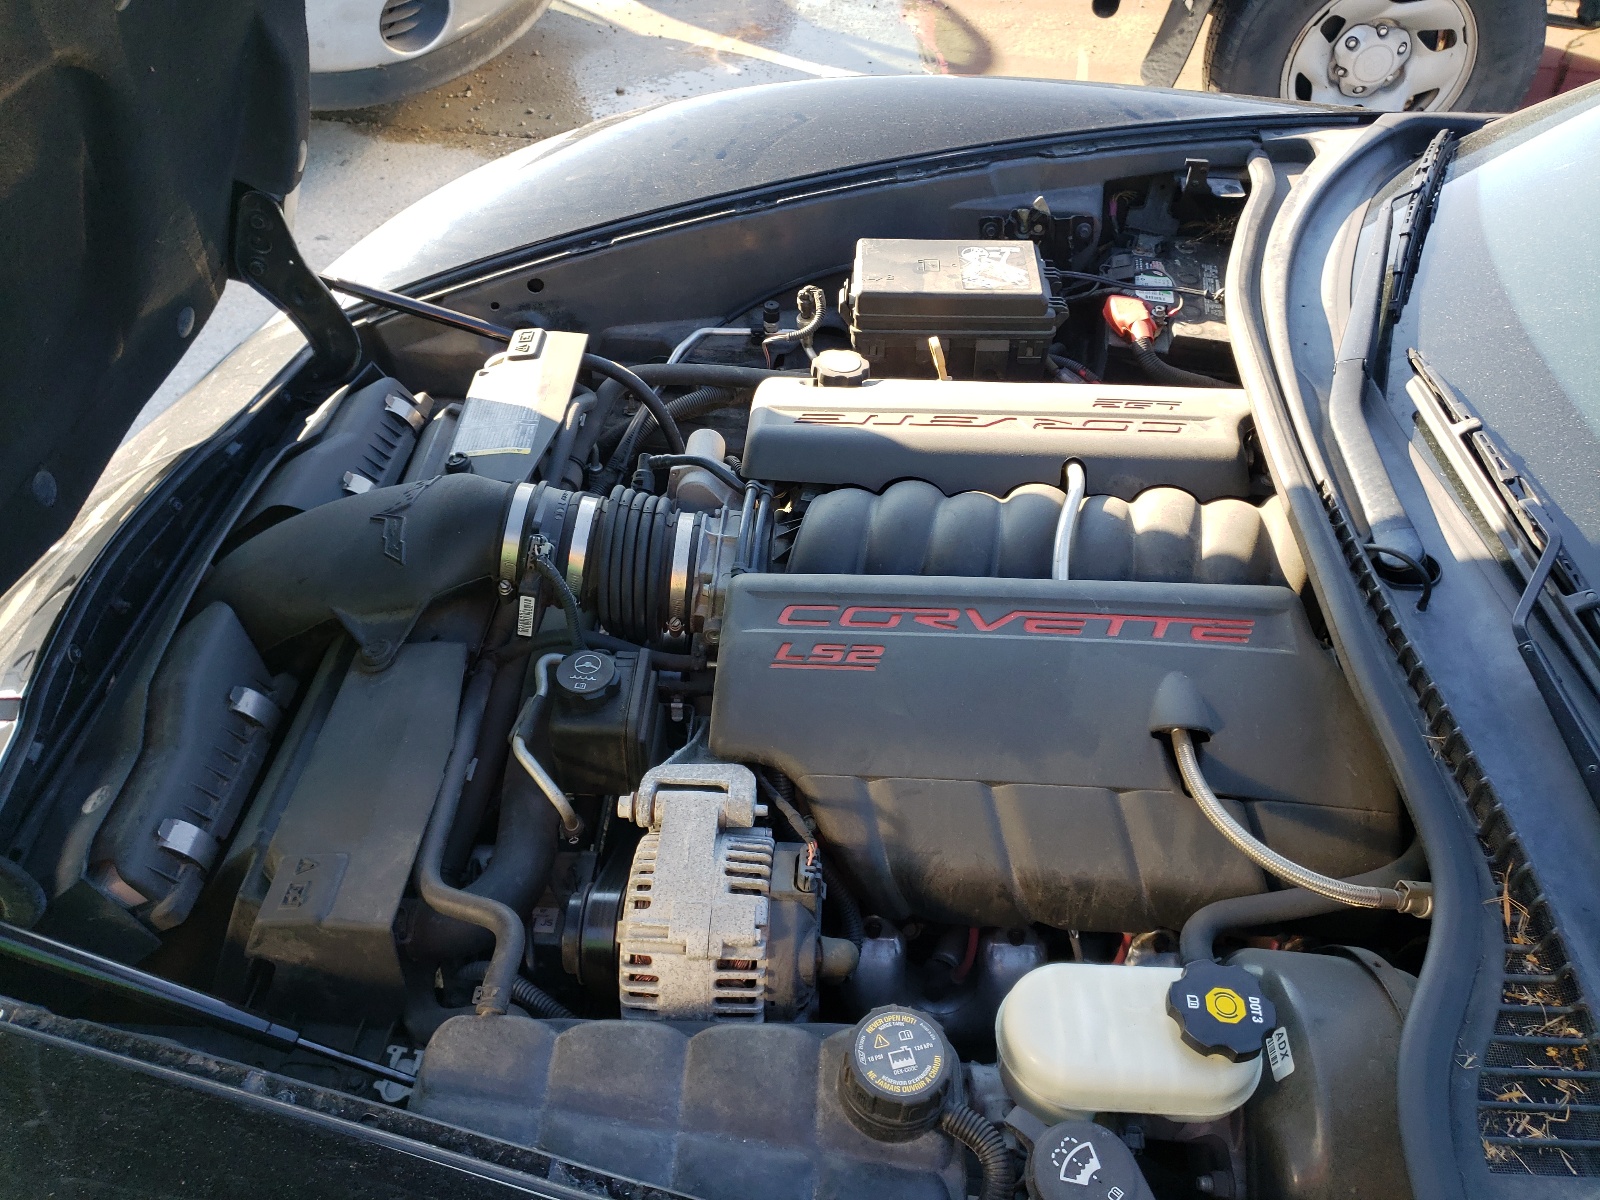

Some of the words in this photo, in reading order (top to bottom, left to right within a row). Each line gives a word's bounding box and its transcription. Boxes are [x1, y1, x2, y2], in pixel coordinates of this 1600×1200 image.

[777, 604, 1255, 643] CORVETTE
[773, 642, 885, 665] LS2
[1248, 996, 1263, 1018] DOT
[865, 1018, 884, 1034] NEVER
[884, 1014, 901, 1023] OPEN
[901, 1015, 917, 1025] HOT!
[1251, 1016, 1264, 1024] 3
[923, 1042, 934, 1050] kPa
[1275, 1032, 1290, 1061] ADX
[874, 1053, 884, 1062] PSI
[866, 1070, 878, 1081] NE
[875, 1078, 901, 1093] JAMAIS
[901, 1080, 927, 1093] OUVRIR
[929, 1055, 942, 1079] CHAUD!
